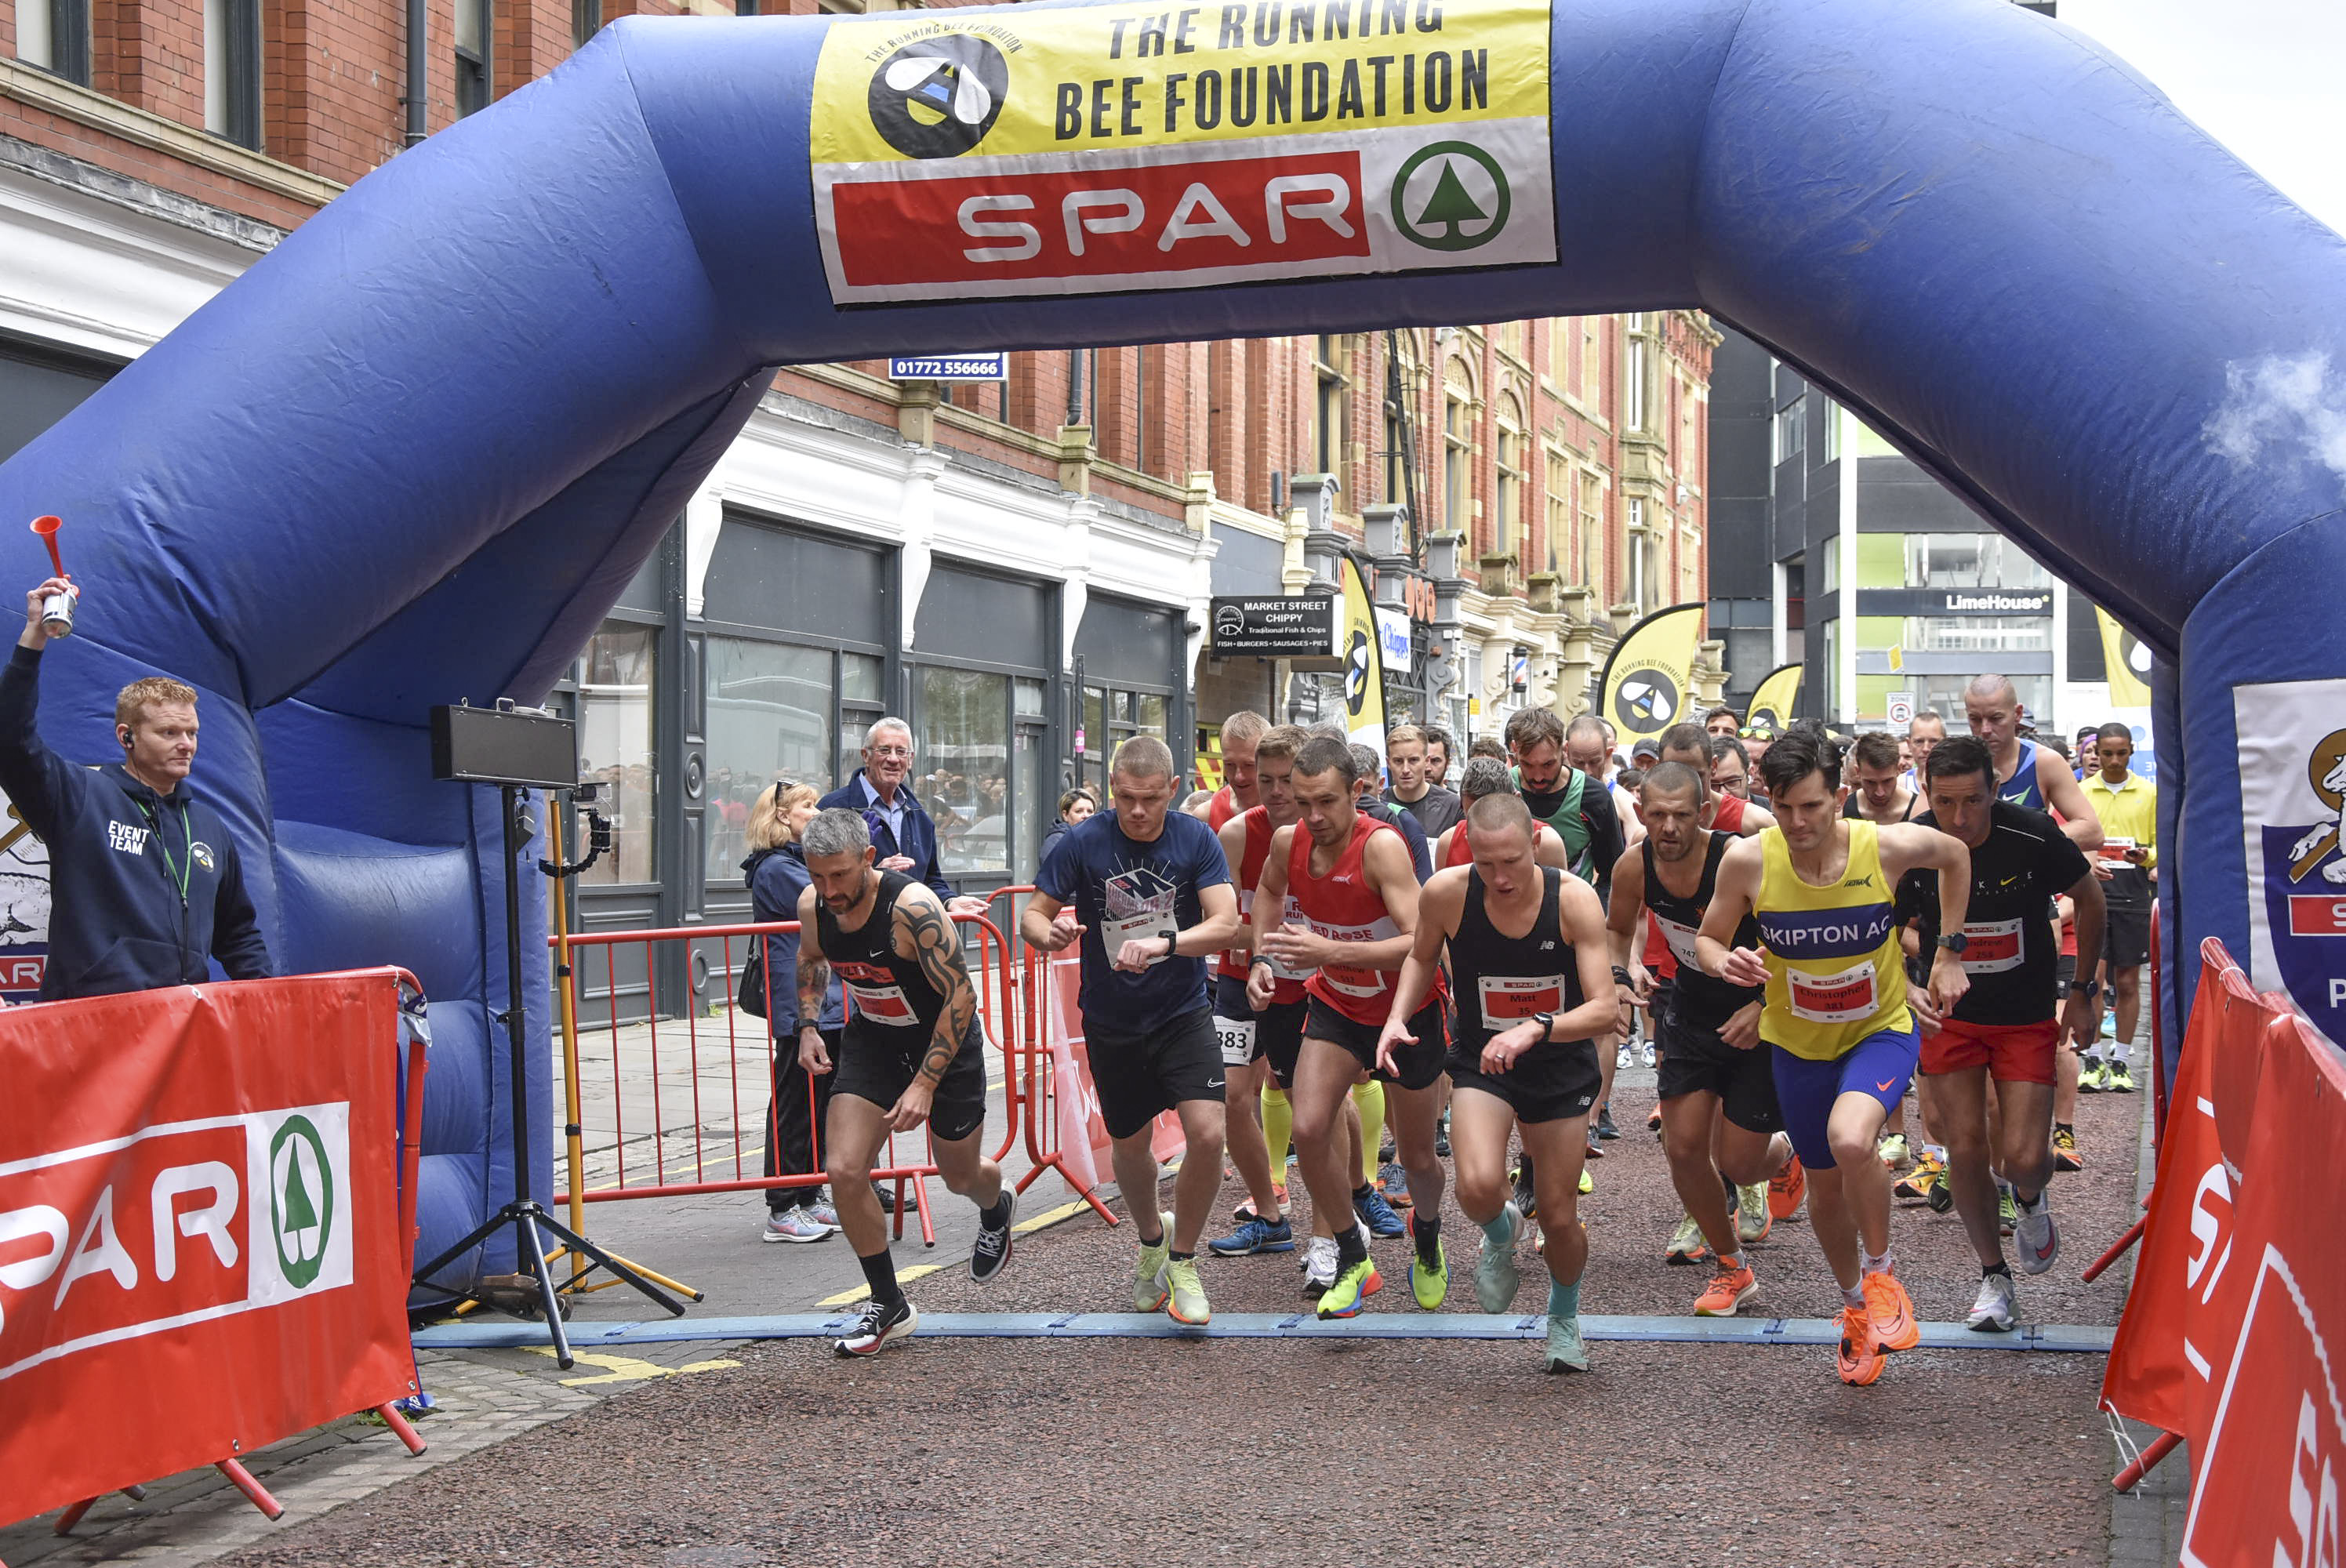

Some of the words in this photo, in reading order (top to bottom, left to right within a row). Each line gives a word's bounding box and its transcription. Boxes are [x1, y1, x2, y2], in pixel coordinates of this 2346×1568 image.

[1109, 8, 1200, 60] THE
[1218, 0, 1444, 49] RUNNING
[865, 45, 889, 63] THE
[888, 23, 940, 48] RUNNING
[1055, 76, 1145, 141] BEE
[1164, 49, 1490, 133] FOUNDATION
[957, 172, 1355, 263] SPAR
[896, 361, 941, 375] 01772
[944, 361, 998, 375] 556666
[1244, 602, 1285, 611] MARKET
[1288, 601, 1328, 611] STREET
[1946, 594, 2043, 611] LimeHouse
[1266, 614, 1303, 622] CHIPPY
[108, 820, 150, 844] EVENT
[109, 833, 143, 856] TEAM
[1760, 924, 1859, 946] SKIPTON
[1865, 914, 1890, 939] AC
[1968, 938, 2003, 948] ndrew
[1510, 994, 1538, 1003] Matt
